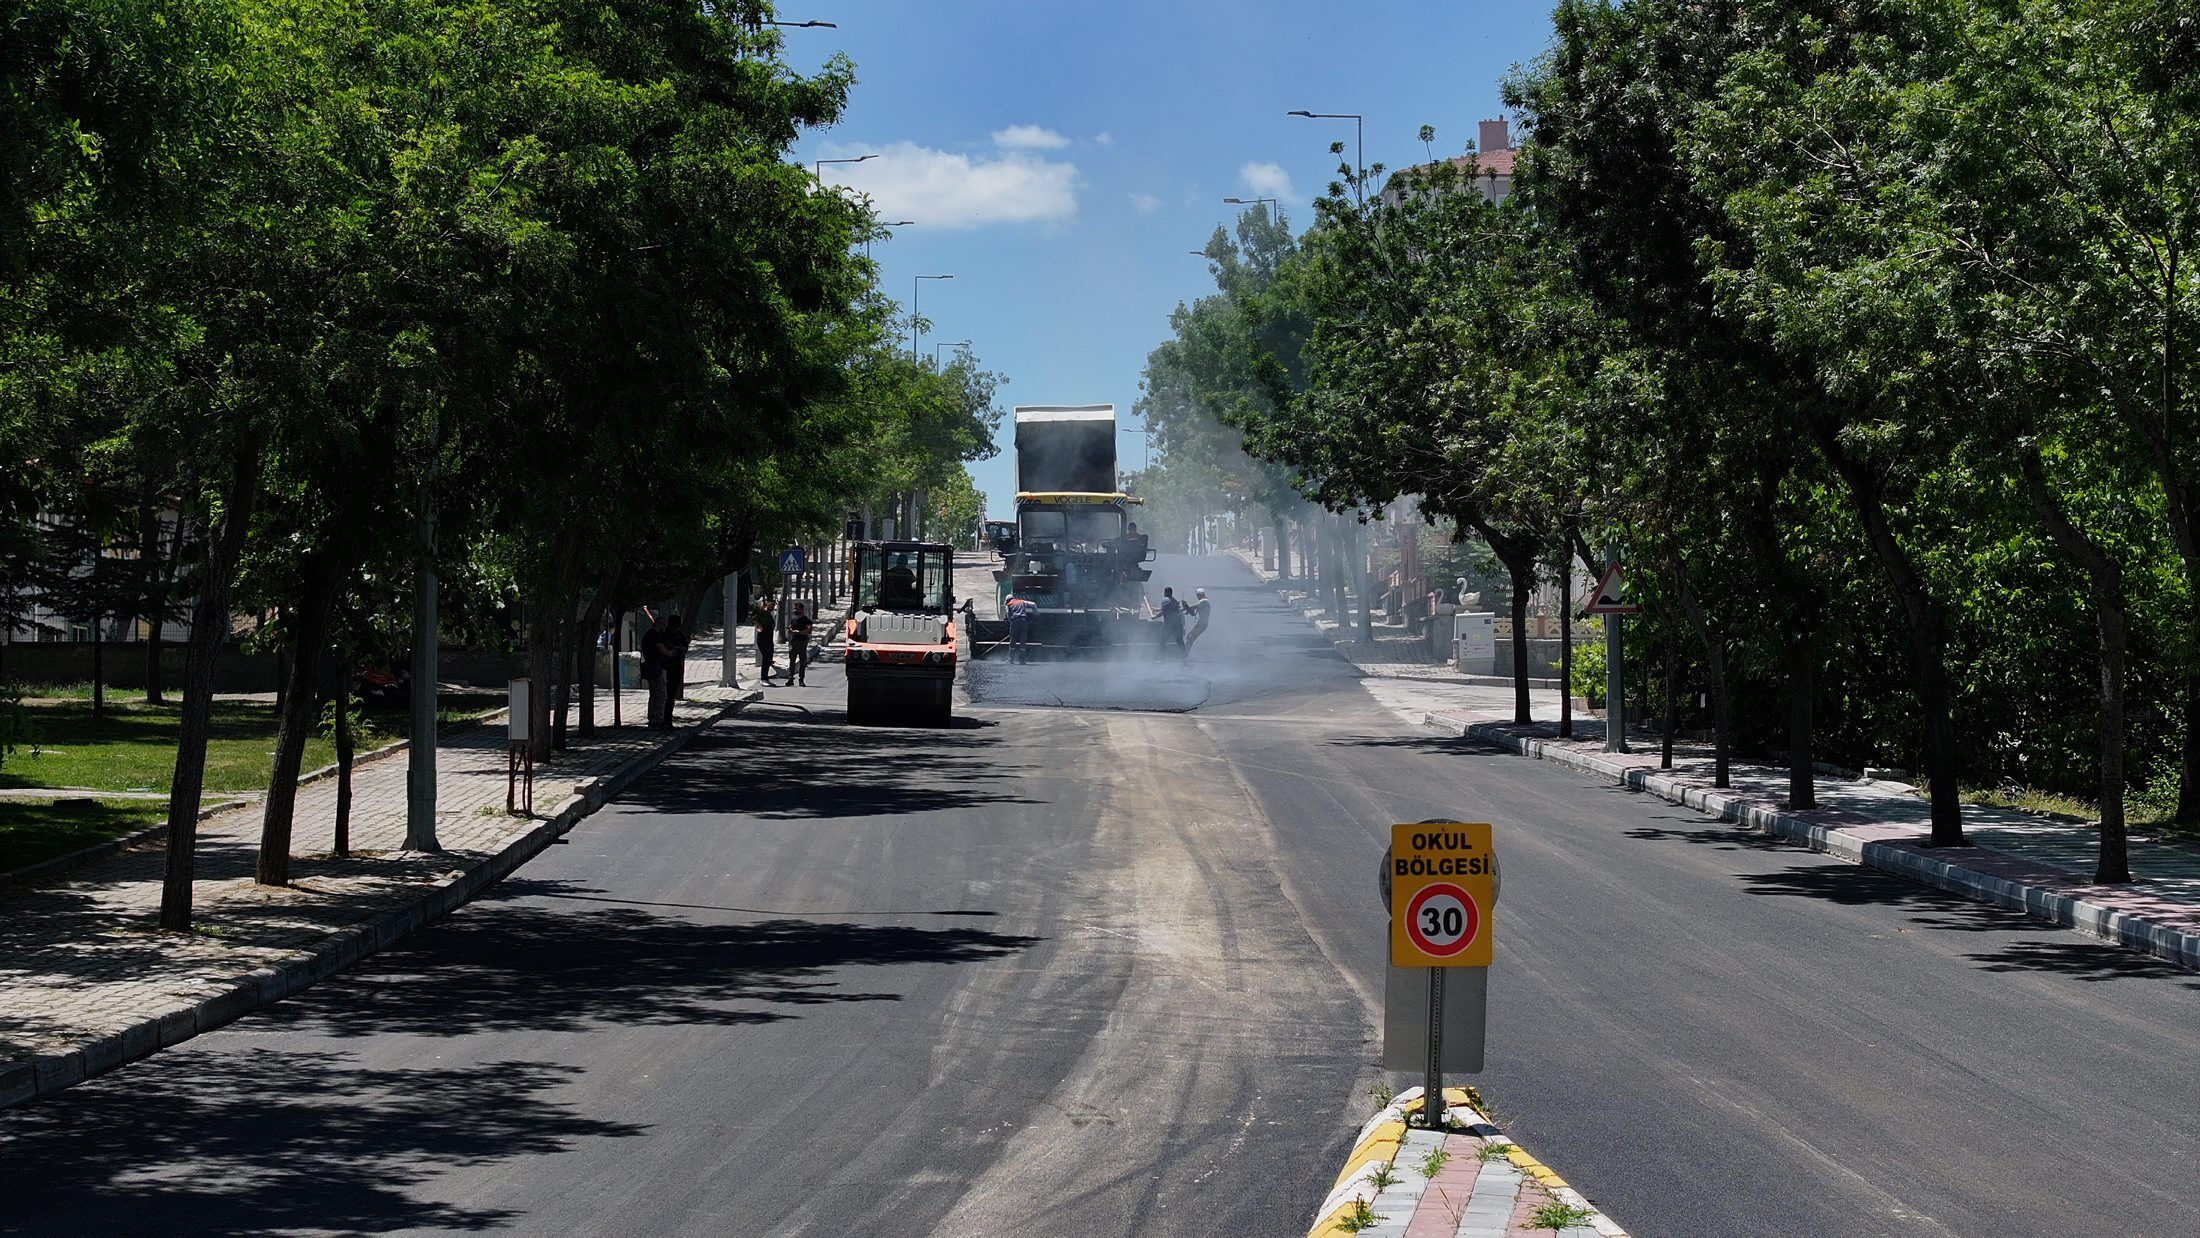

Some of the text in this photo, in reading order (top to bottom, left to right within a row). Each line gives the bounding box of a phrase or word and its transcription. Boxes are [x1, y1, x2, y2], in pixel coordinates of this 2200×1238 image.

[1411, 832, 1472, 850] OKUL
[1395, 854, 1489, 876] BÖLGESİ
[1421, 907, 1463, 937] 30
